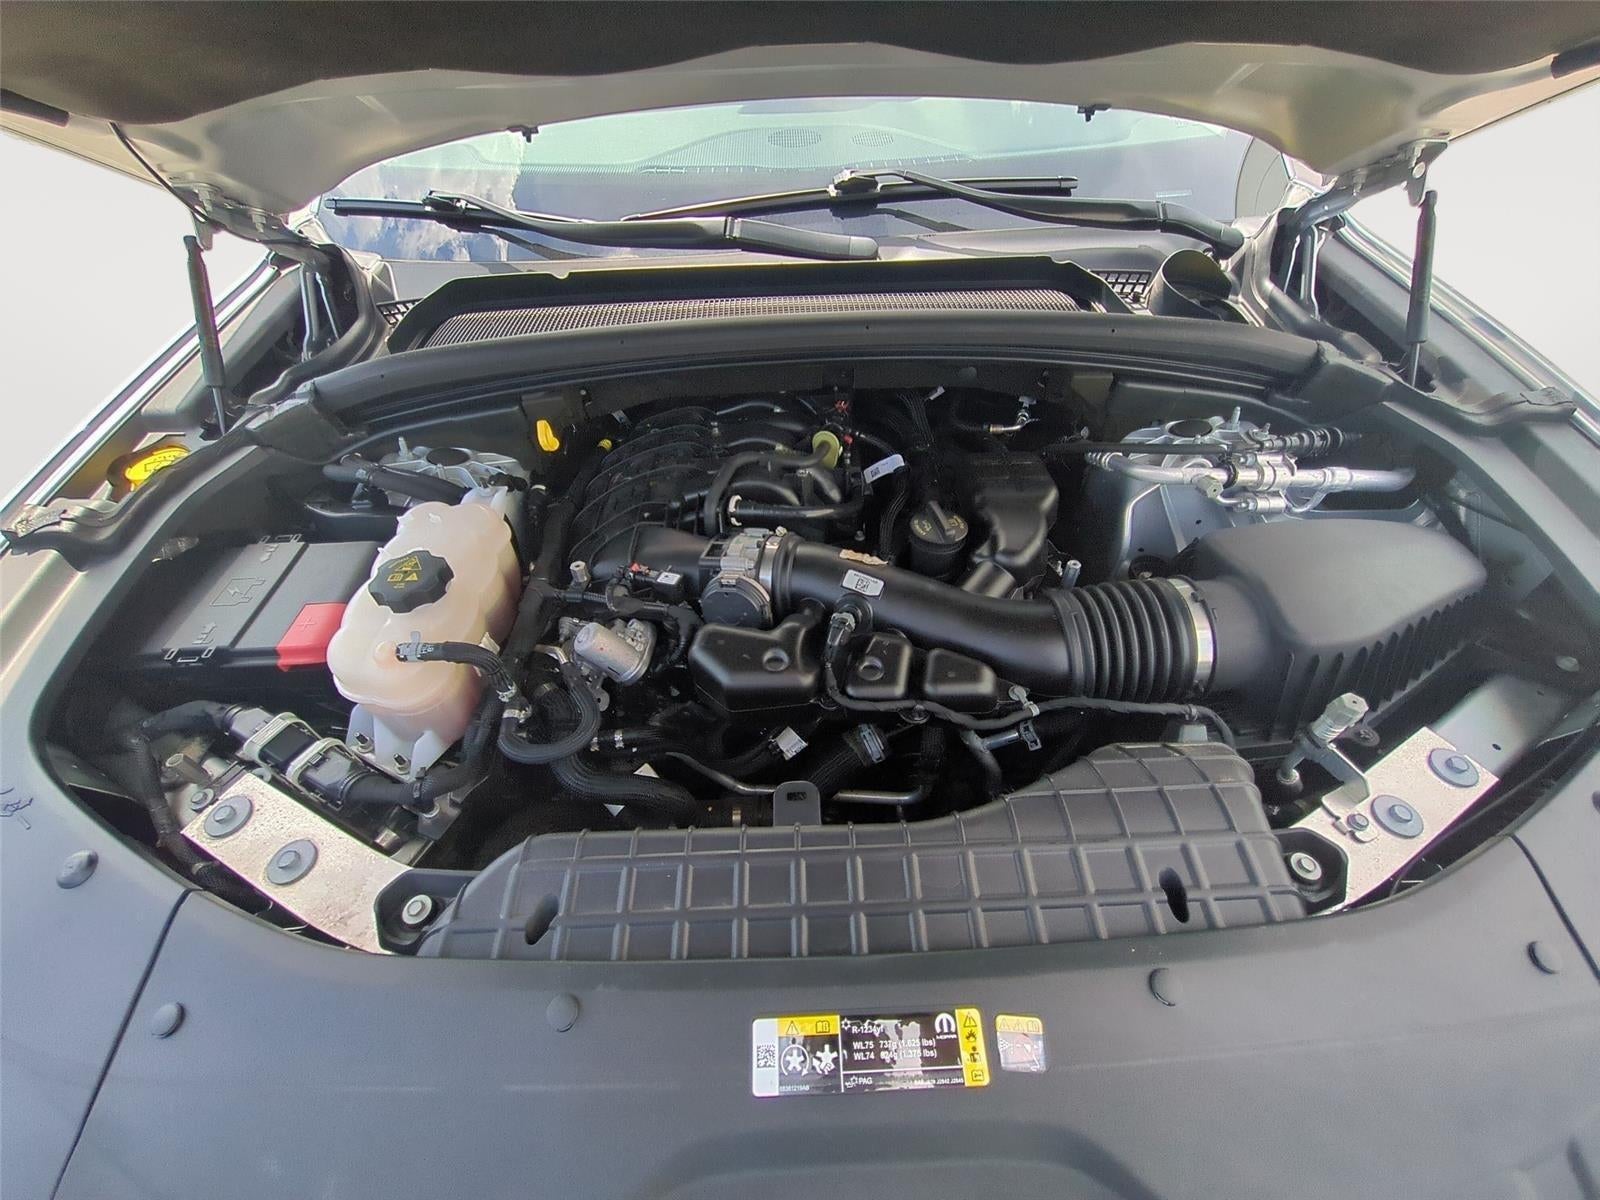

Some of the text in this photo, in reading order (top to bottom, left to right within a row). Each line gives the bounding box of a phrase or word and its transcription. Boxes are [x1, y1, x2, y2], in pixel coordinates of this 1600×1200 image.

[852, 1041, 874, 1050] WL75
[921, 1037, 936, 1048] lbs)
[853, 1051, 875, 1061] WL74
[922, 1048, 937, 1059] lbs)
[858, 1076, 873, 1085] PAG
